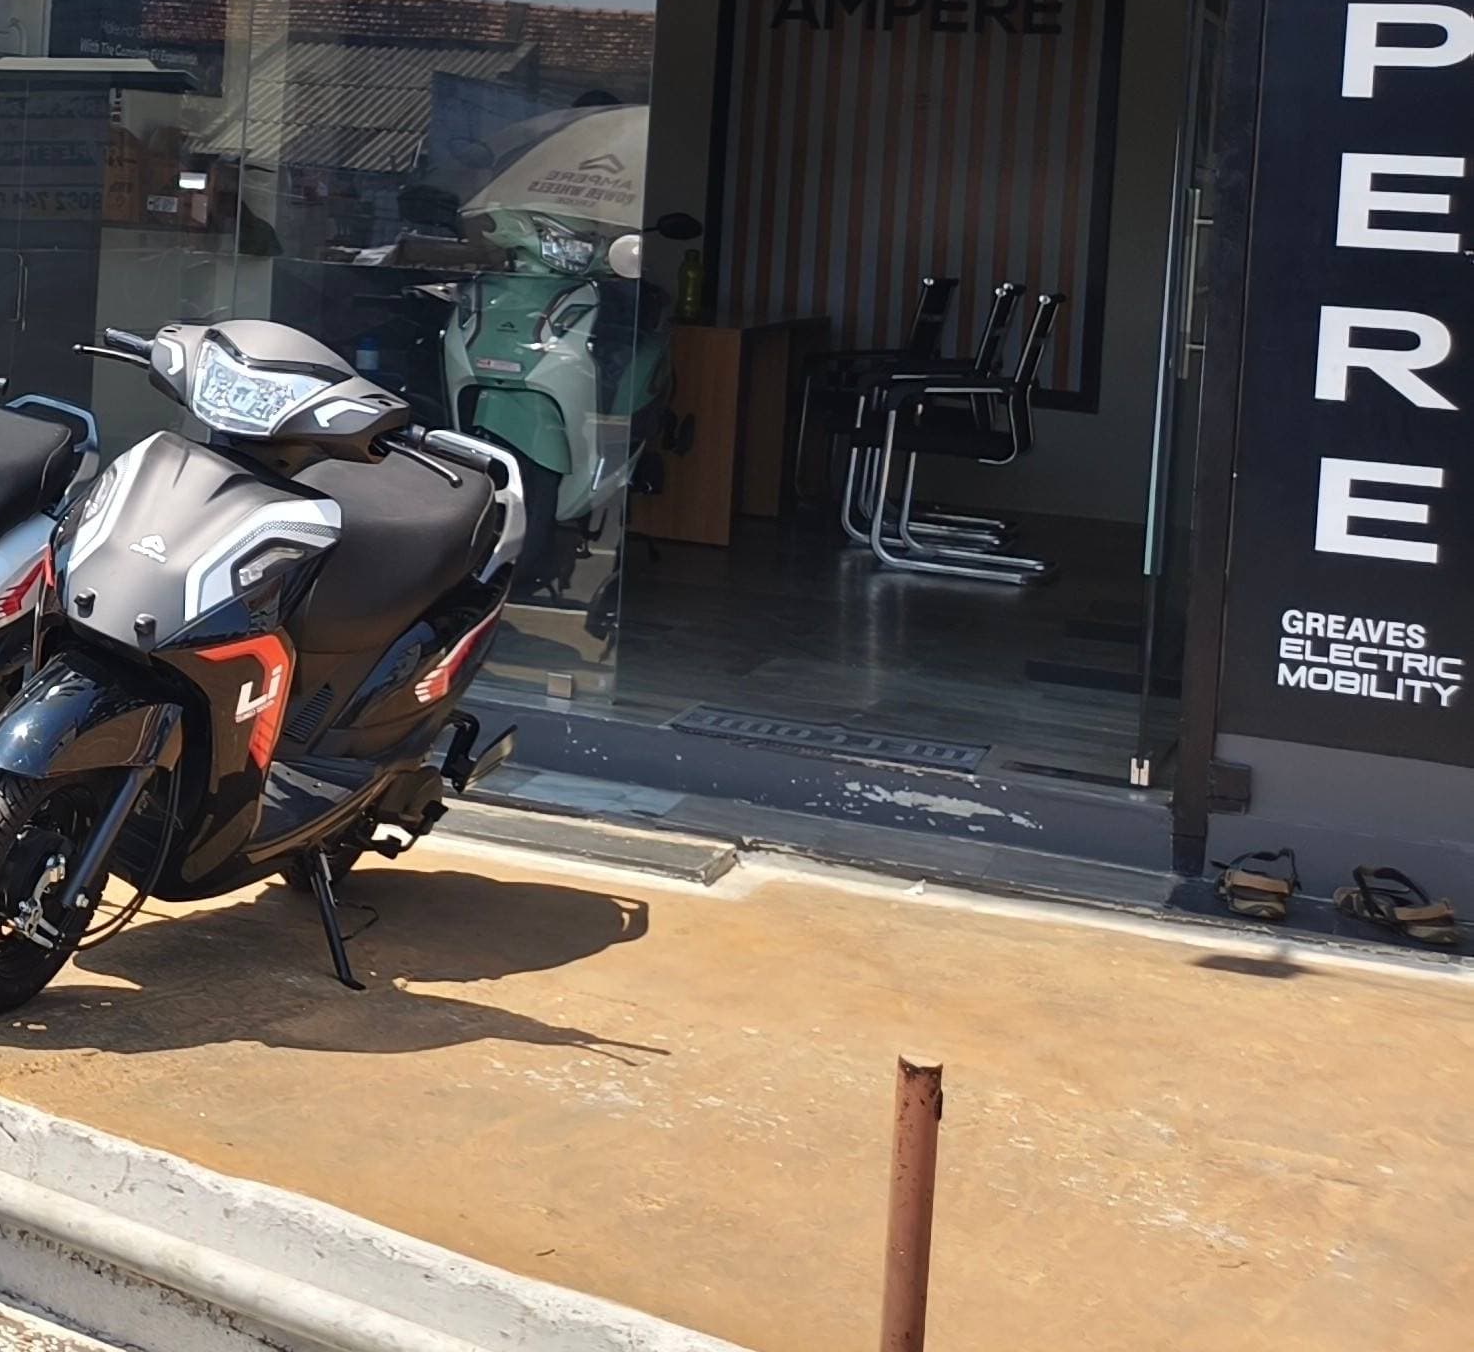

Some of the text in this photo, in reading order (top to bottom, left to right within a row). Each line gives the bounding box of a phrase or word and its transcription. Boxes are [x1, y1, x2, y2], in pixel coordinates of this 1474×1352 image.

[1281, 609, 1426, 649] GREAVES
[1279, 637, 1465, 681] ELECTRIC
[1277, 664, 1462, 708] MOBILITY
